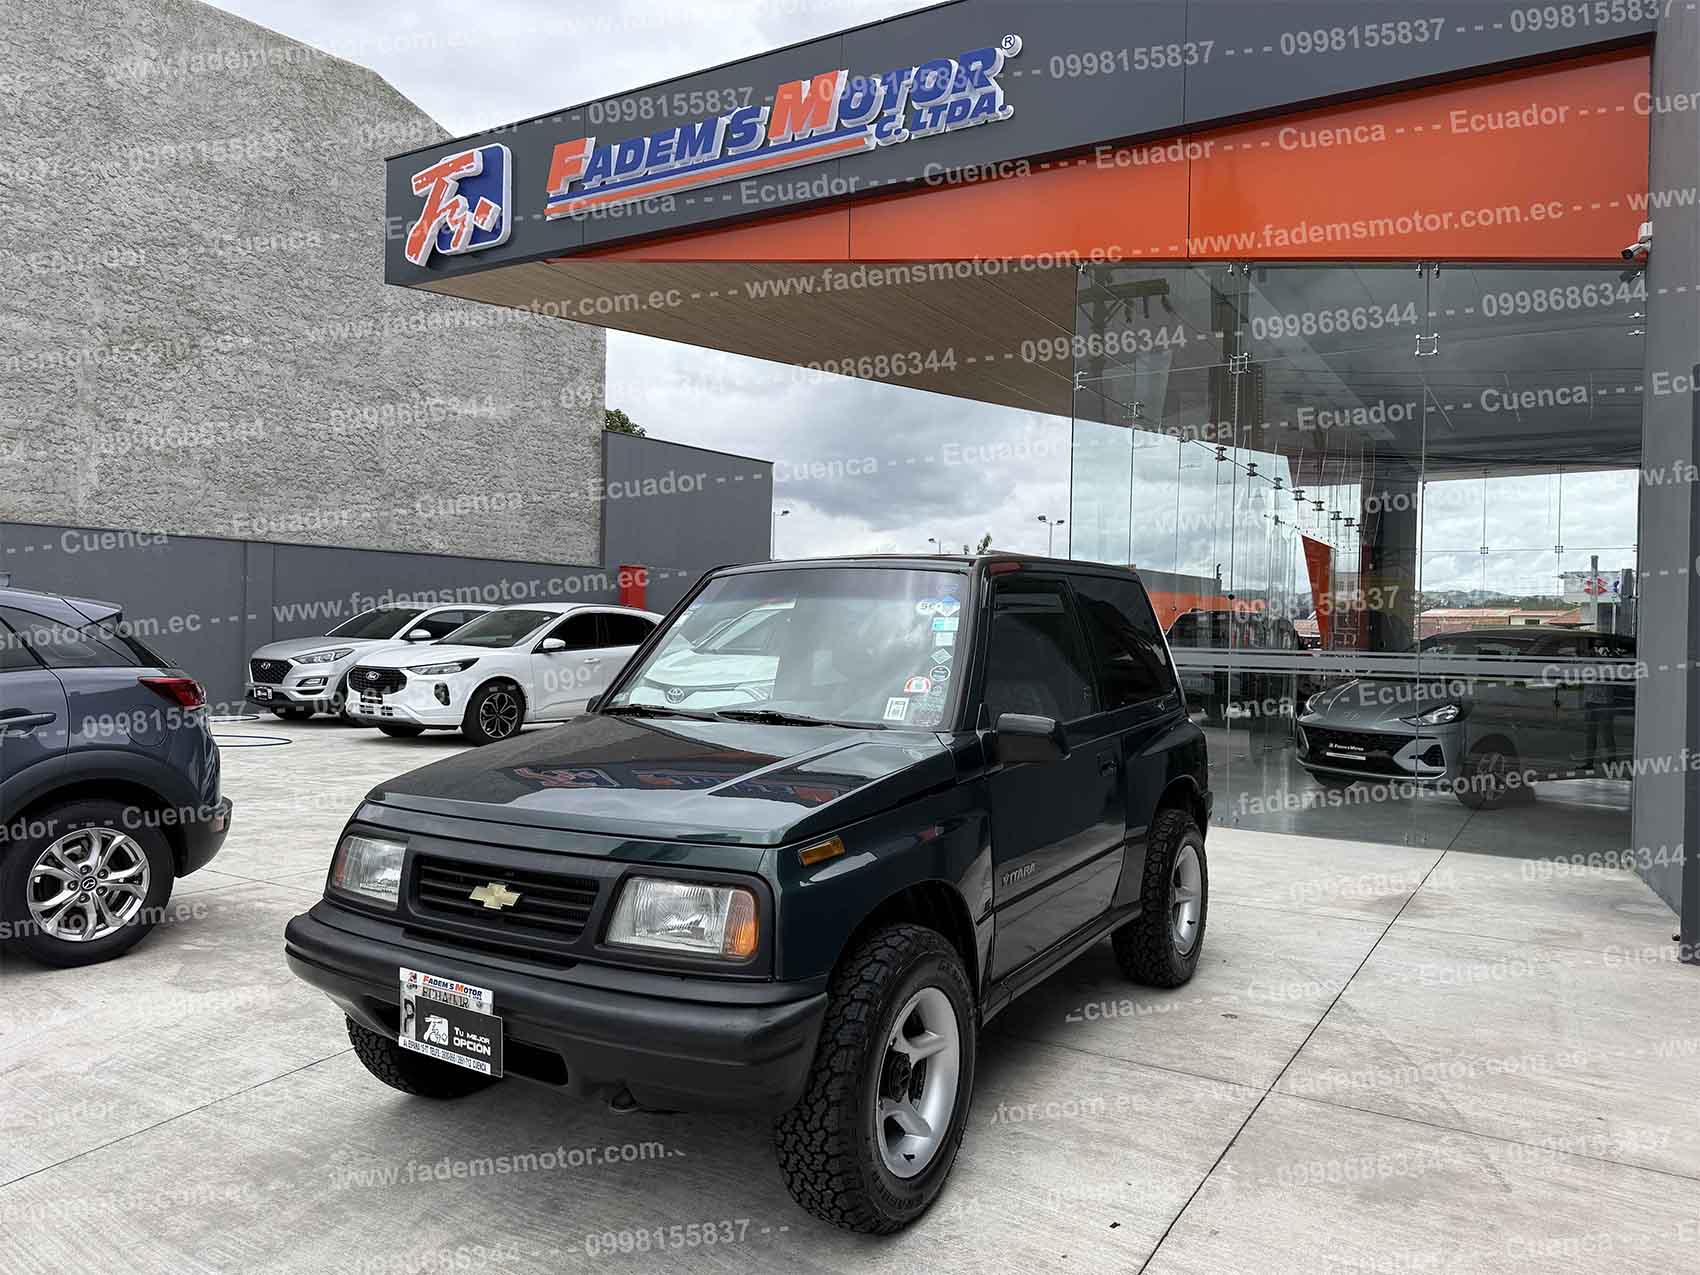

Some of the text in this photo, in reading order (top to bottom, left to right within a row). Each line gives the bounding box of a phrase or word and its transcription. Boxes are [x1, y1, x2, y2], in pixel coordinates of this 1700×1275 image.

[546, 104, 770, 198] FADEM'S
[767, 46, 1005, 146] MOTOR
[910, 91, 1015, 139] LTDA.
[455, 983, 482, 997] MOTOR
